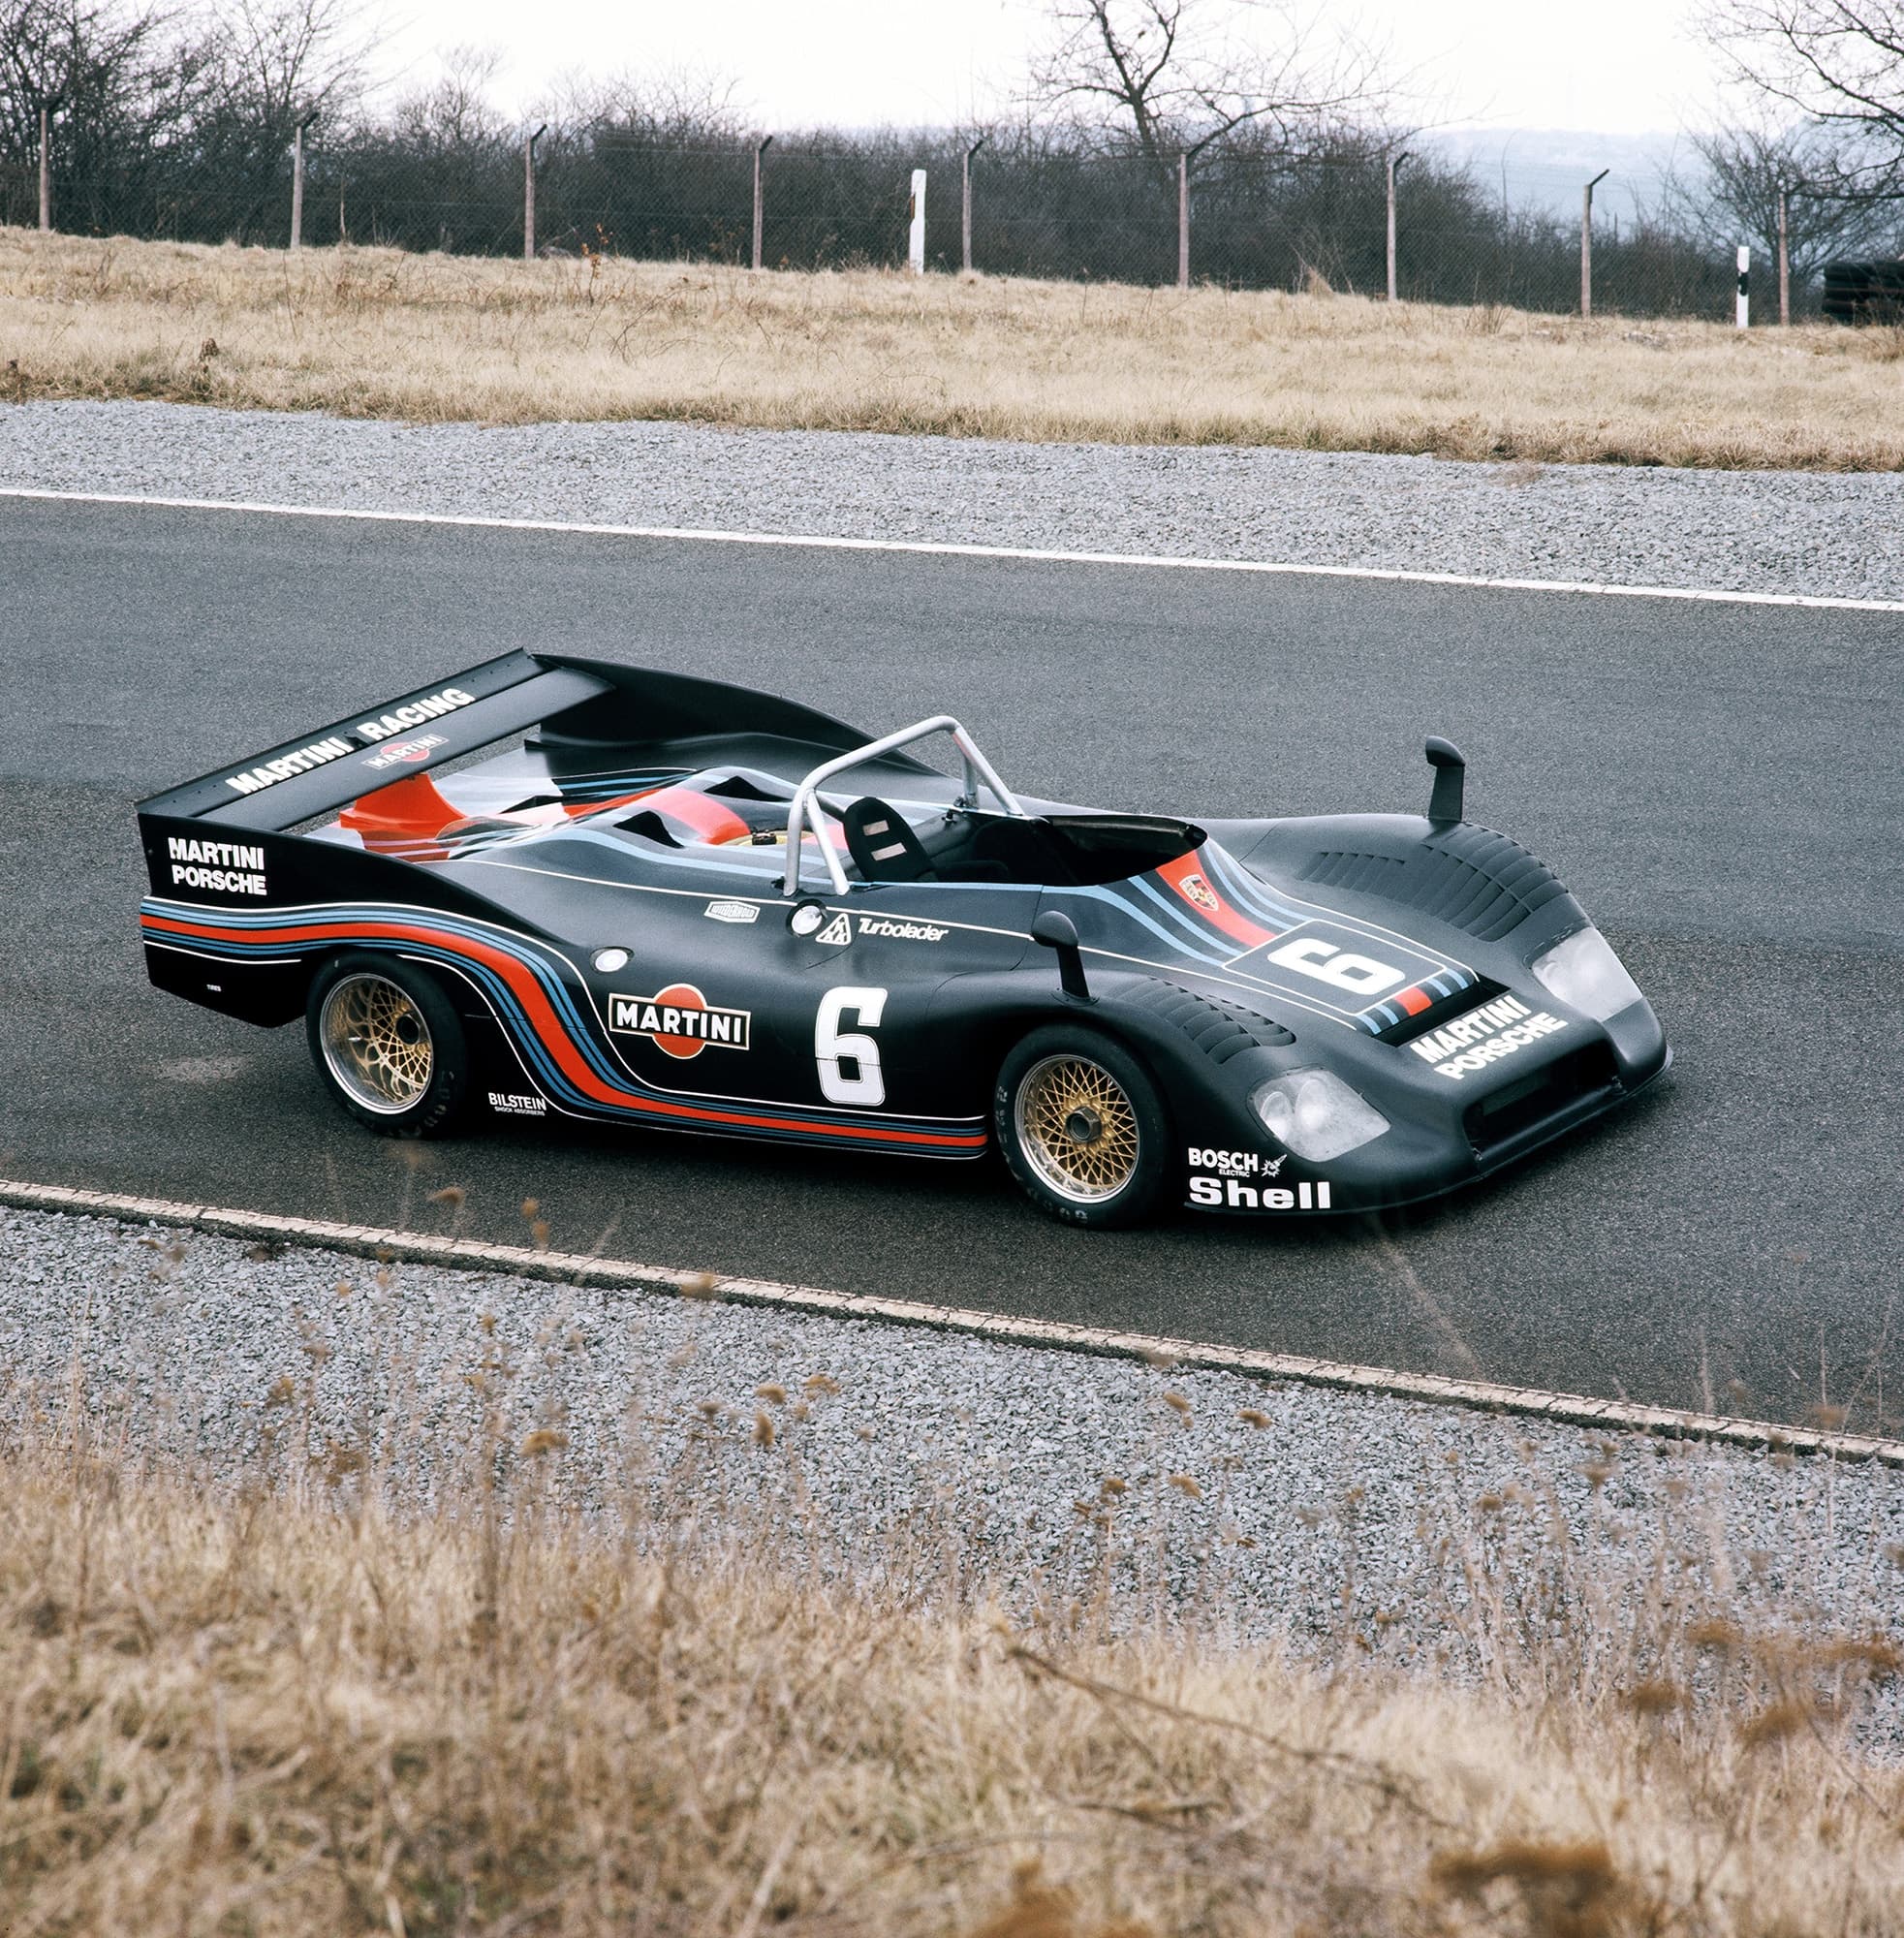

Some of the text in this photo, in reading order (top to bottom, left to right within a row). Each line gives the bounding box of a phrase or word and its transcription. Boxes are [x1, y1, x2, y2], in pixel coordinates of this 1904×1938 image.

[225, 687, 477, 795] MARTINI RACING
[367, 735, 443, 767] MARTINI
[168, 837, 265, 870] MARTINI
[172, 864, 267, 895] PORSCHE
[858, 917, 949, 942] Turbolader
[1267, 937, 1406, 995] 6
[616, 1001, 741, 1044] MARTINI
[1410, 994, 1532, 1064] MARTINI
[815, 985, 888, 1106] 6
[1434, 1012, 1569, 1080] PORSCHE
[488, 1091, 547, 1111] BILSTEIN
[1188, 1147, 1259, 1172] BOSCH
[1218, 1168, 1251, 1178] ELECTRIC
[1189, 1176, 1331, 1210] Shell
